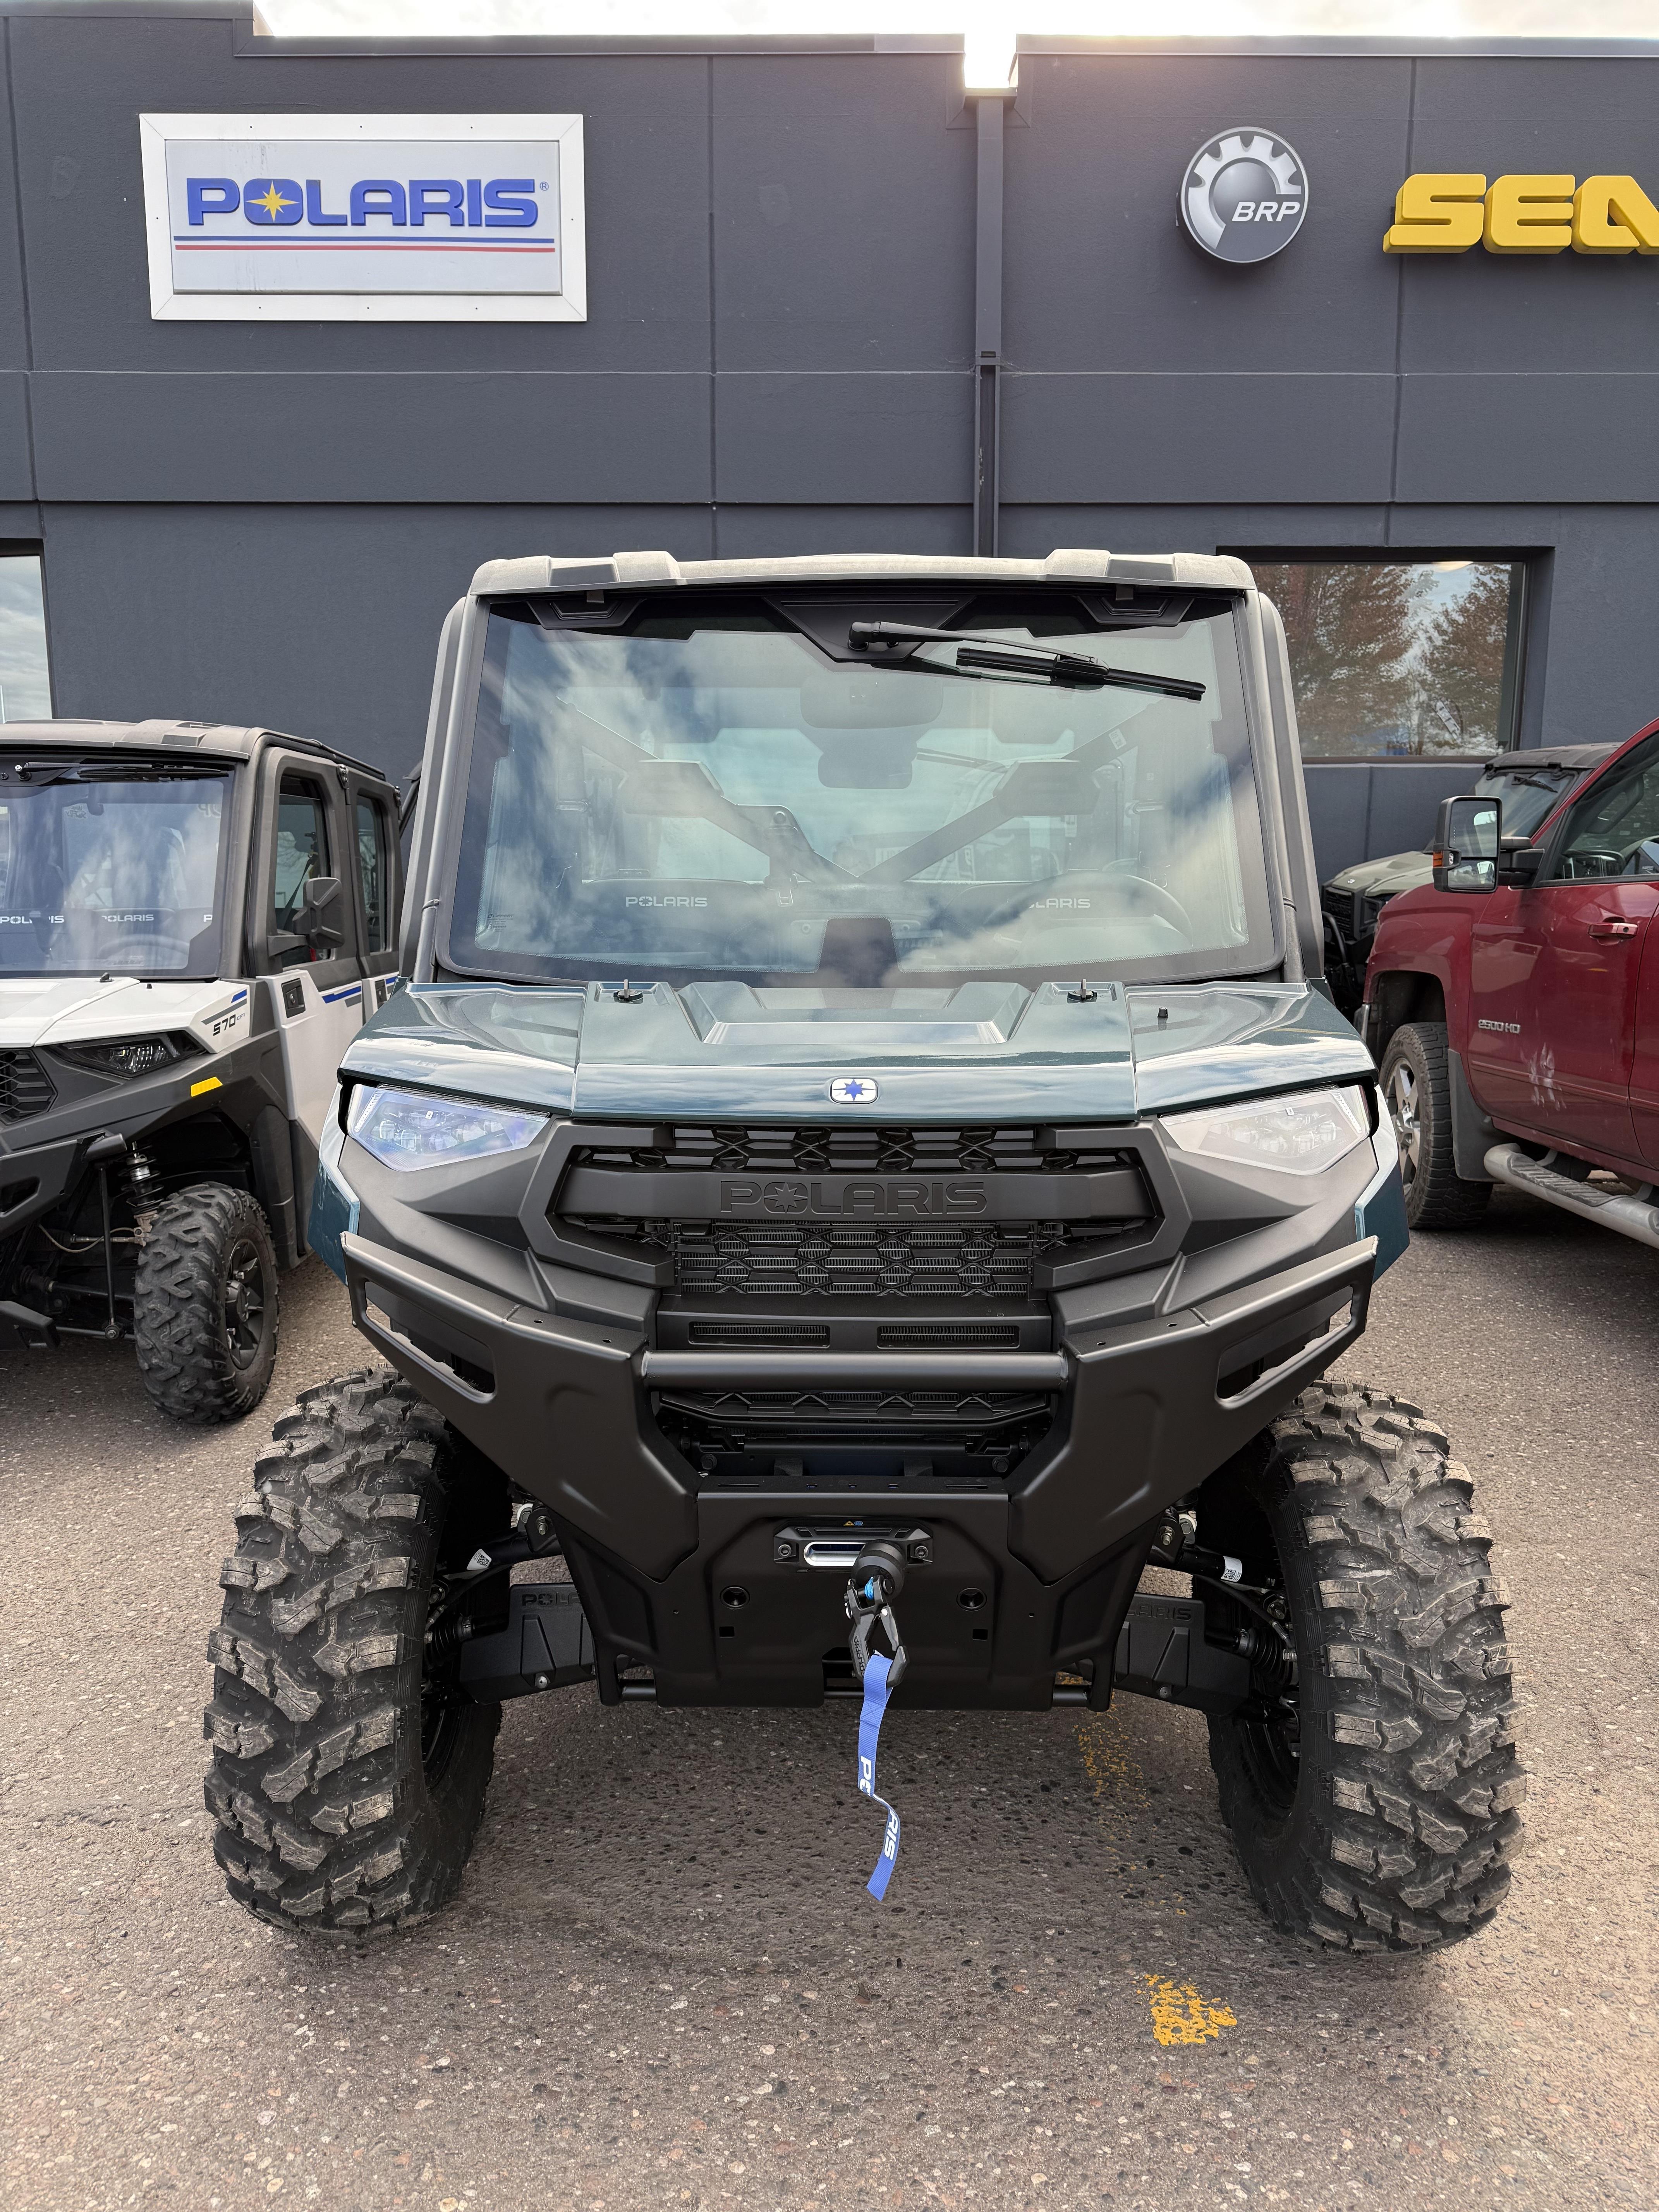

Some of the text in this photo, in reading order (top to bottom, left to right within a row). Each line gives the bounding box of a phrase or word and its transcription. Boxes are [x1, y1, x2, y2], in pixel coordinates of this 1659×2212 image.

[187, 178, 539, 227] POLARIS
[1232, 201, 1300, 222] BRP
[625, 896, 708, 907] POLARIS
[0, 915, 64, 924] POLIS
[213, 1014, 236, 1036] 570
[1478, 1019, 1521, 1034] 2500 HD
[720, 1180, 987, 1215] POLARIS
[522, 1592, 581, 1607] POLA
